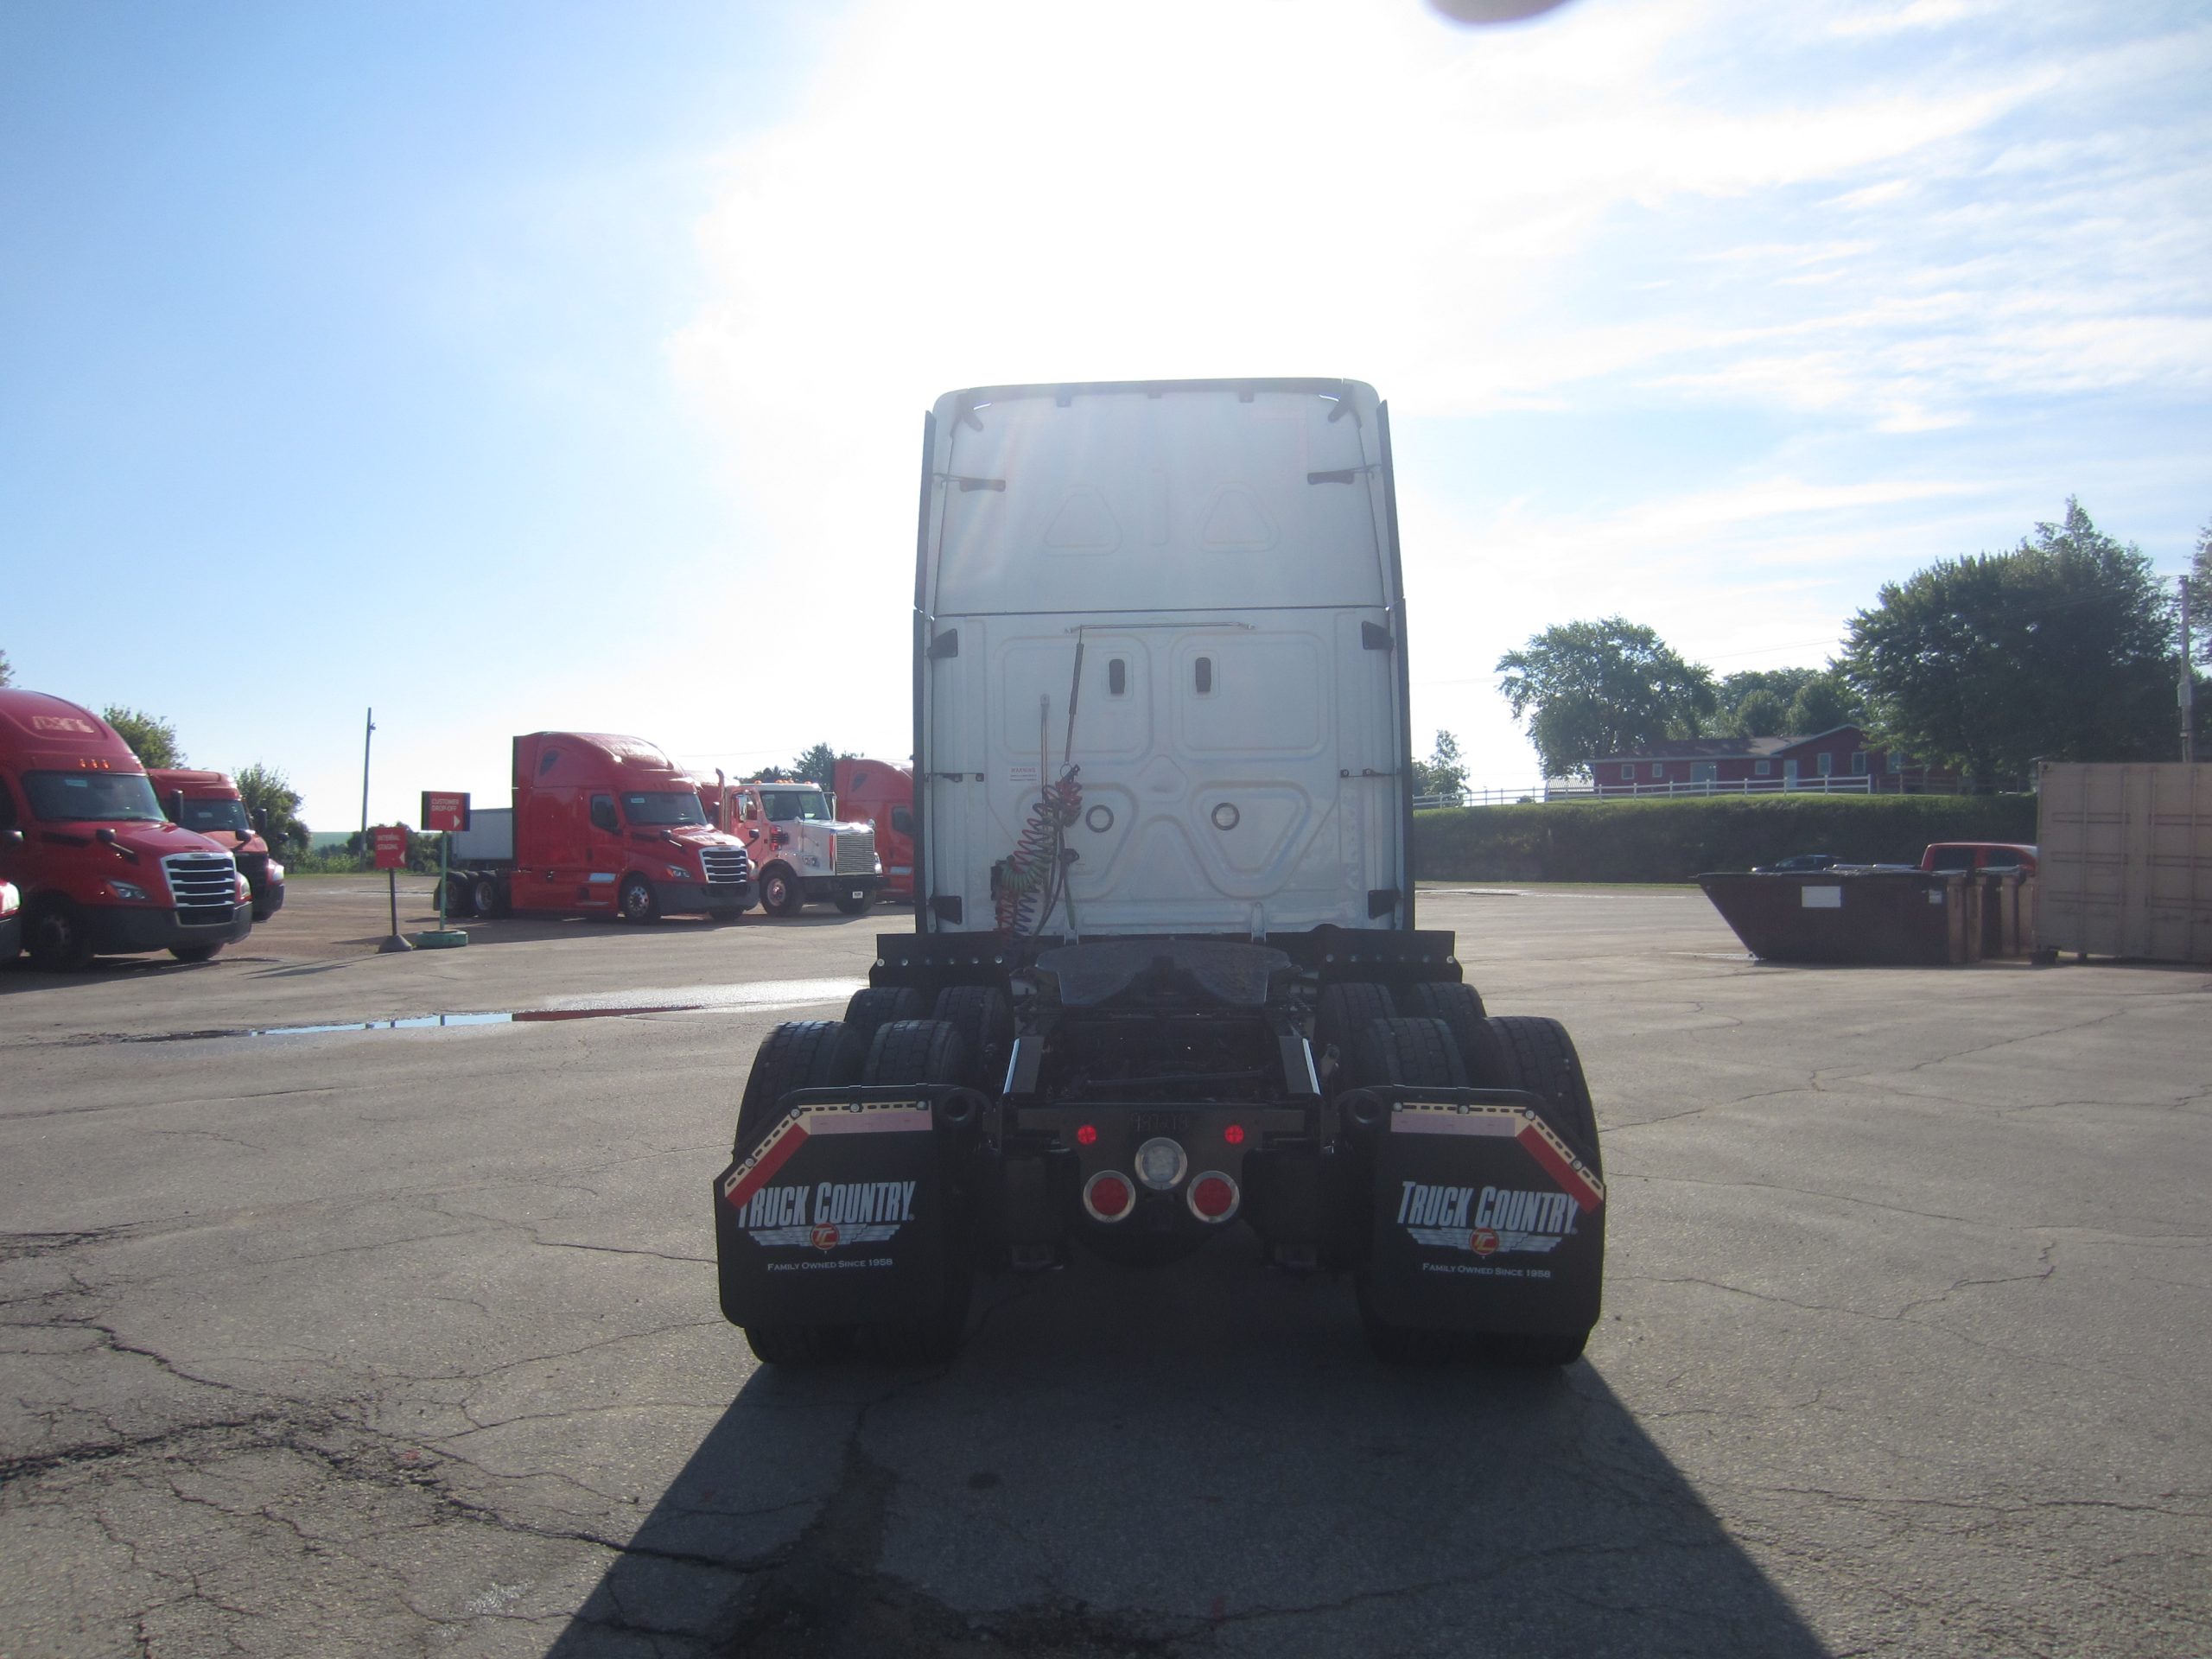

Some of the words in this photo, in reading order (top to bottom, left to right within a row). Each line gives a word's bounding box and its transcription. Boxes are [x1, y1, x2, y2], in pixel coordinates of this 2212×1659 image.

[814, 1181, 917, 1224] COUNTRY
[1396, 1181, 1474, 1227] TRUCK
[1474, 1186, 1580, 1235] COUNTRY
[801, 1262, 837, 1270] OWNED
[838, 1260, 867, 1268] SINCE
[868, 1258, 893, 1267] 1958
[1422, 1262, 1456, 1272] FAMILY
[1457, 1265, 1493, 1274] OWNED
[1494, 1267, 1523, 1277] SINCE
[1526, 1269, 1552, 1278] 1958
